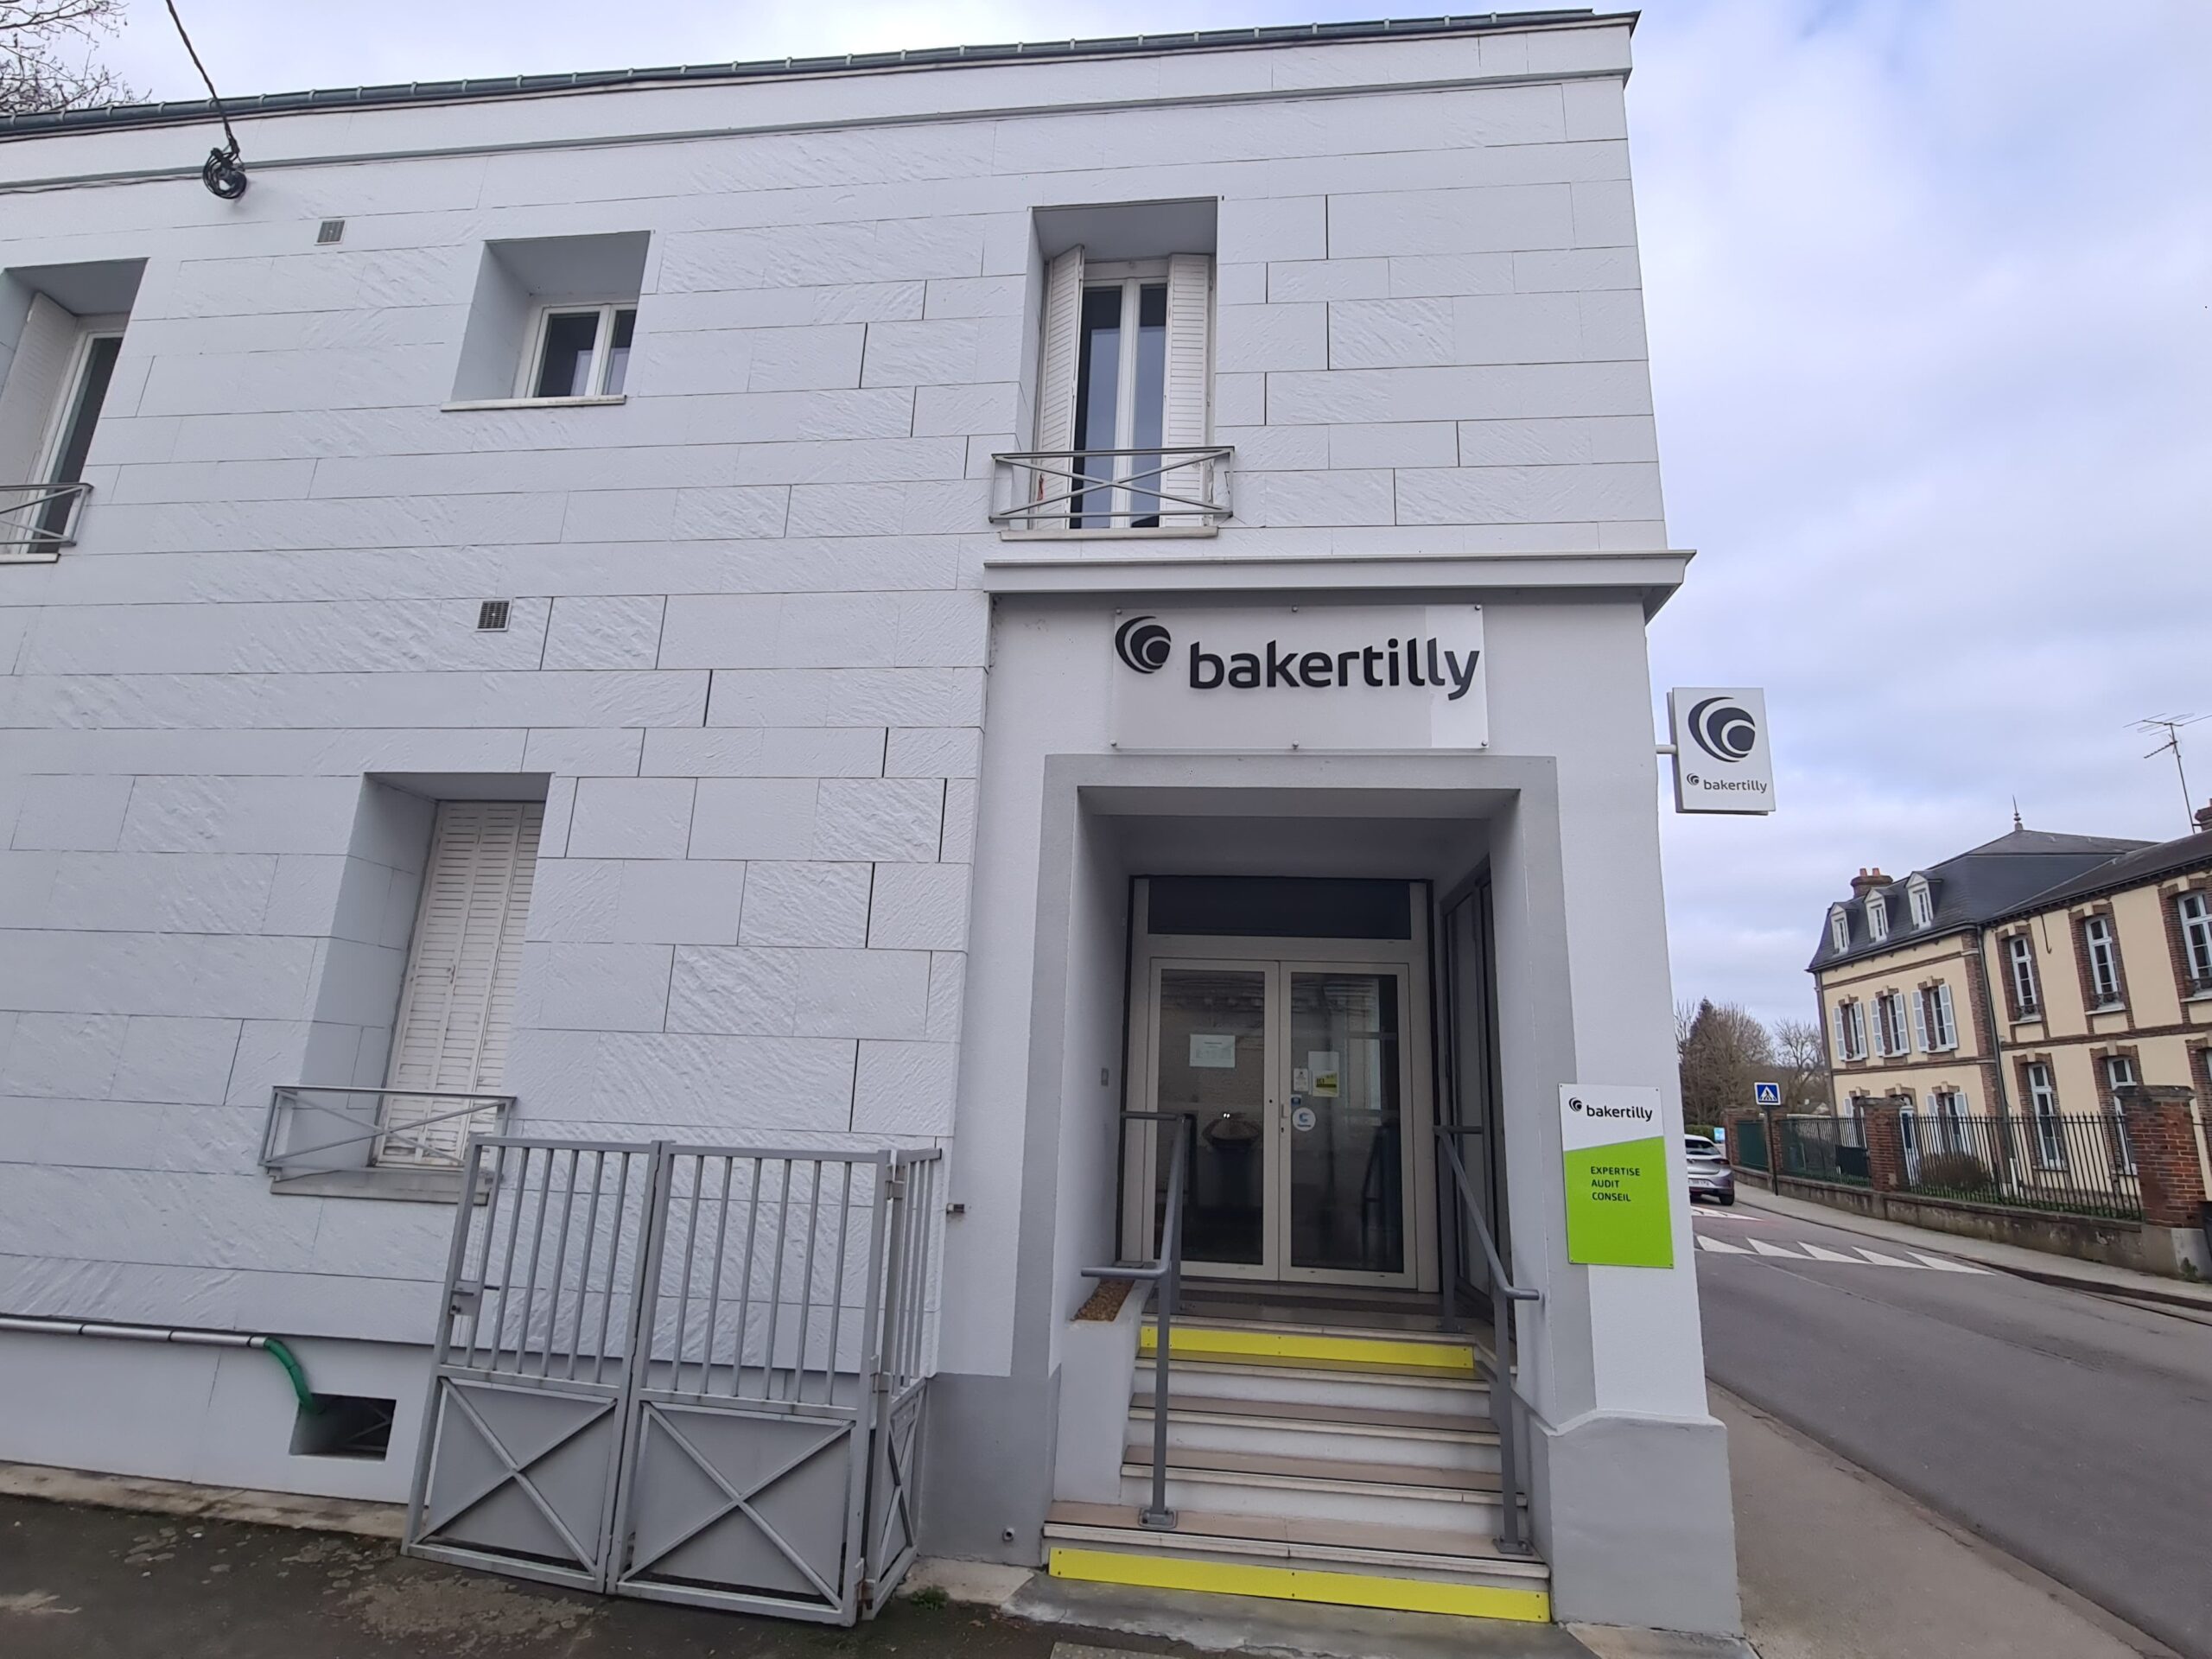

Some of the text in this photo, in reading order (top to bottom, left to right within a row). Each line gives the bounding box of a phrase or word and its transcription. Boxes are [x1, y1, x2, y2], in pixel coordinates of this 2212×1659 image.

[1190, 638, 1480, 701] bakertilly
[1703, 779, 1767, 793] bakertilly
[1586, 1104, 1653, 1122] bakertilly
[1591, 1166, 1641, 1176] EXPERTISE
[1591, 1179, 1619, 1188] AUDIT
[1592, 1192, 1631, 1202] CONSEIL
